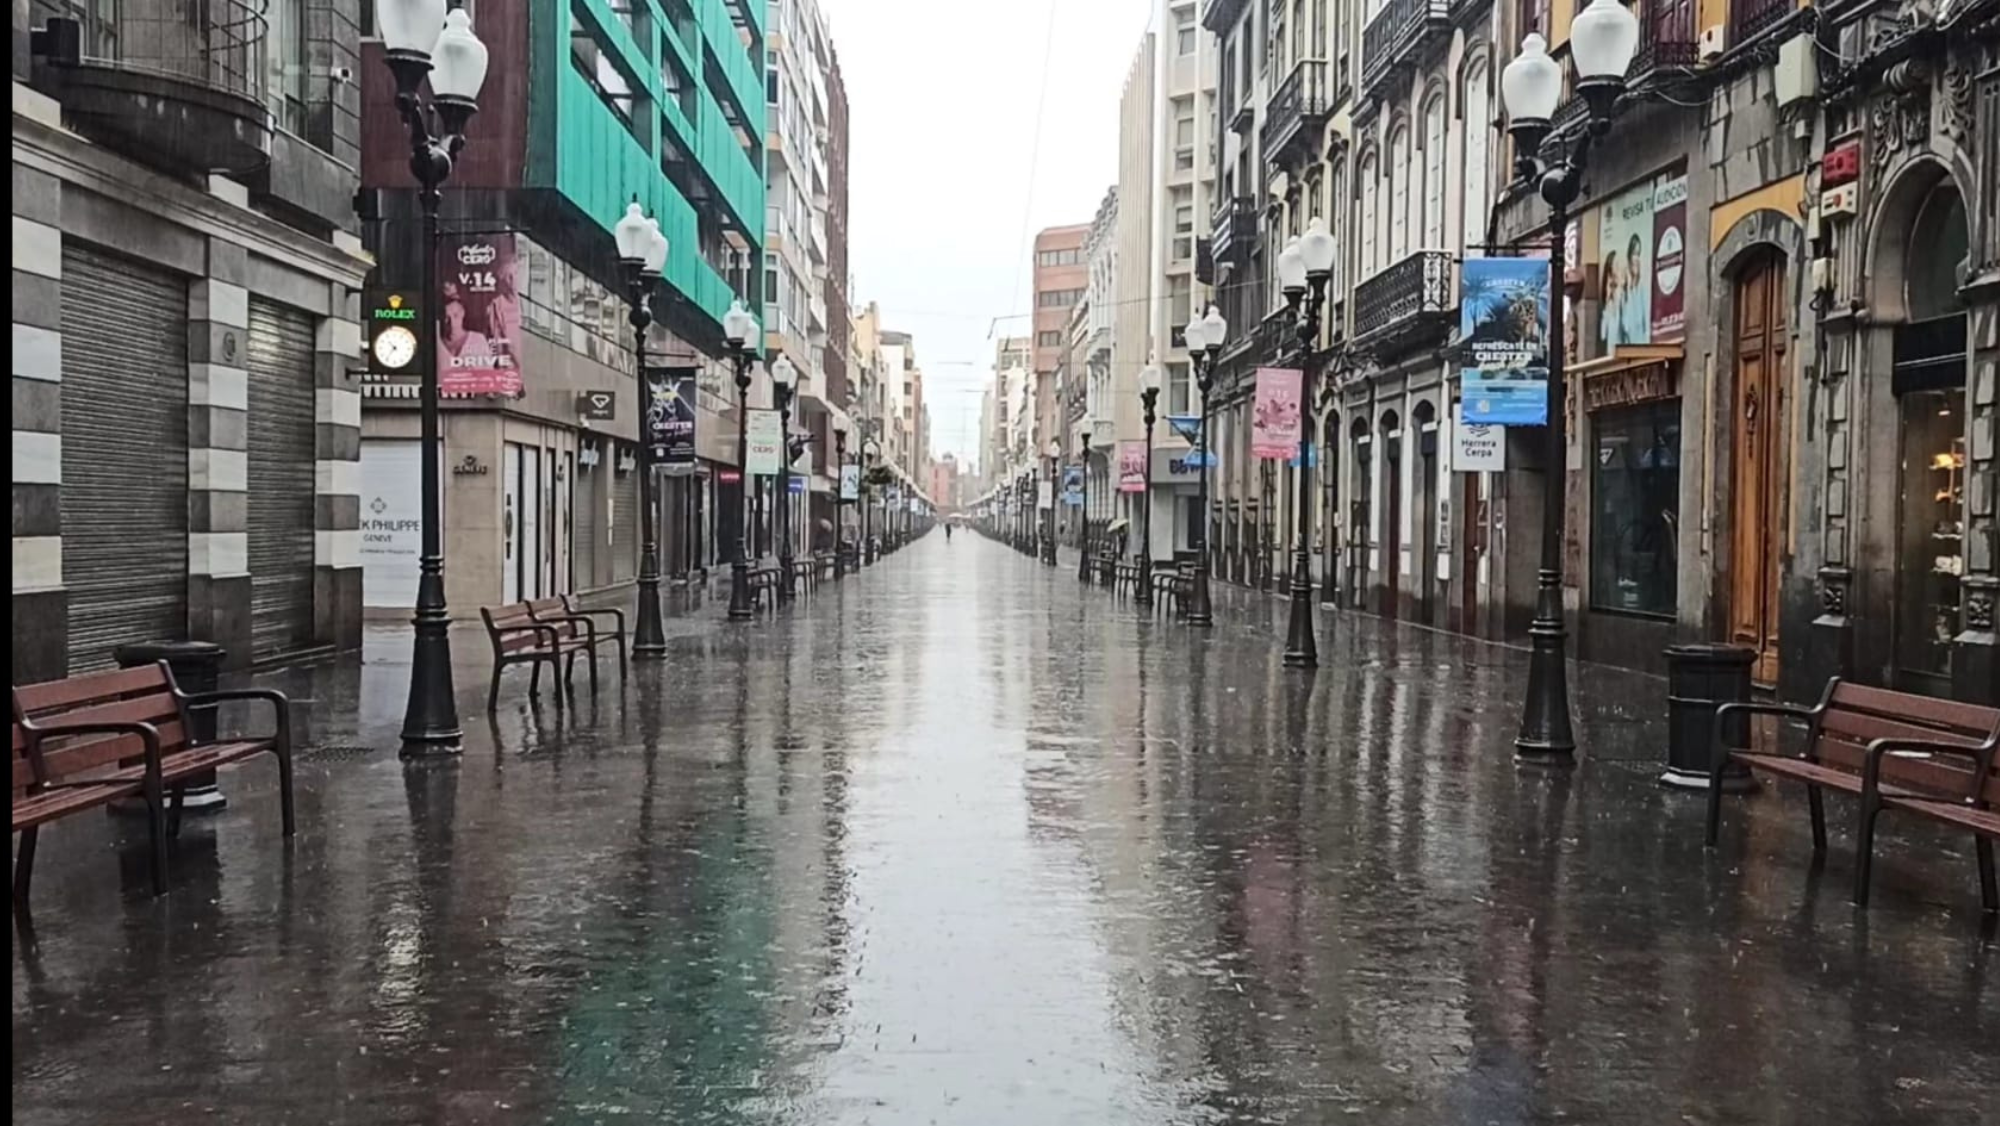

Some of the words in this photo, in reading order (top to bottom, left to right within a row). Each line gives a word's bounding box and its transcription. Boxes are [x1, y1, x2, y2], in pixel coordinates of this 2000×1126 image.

[463, 254, 490, 265] CERO
[375, 308, 415, 320] ROLEX
[450, 354, 511, 368] DRIVE
[1461, 439, 1497, 448] Herrera
[1465, 447, 1493, 458] Cerpa
[371, 519, 420, 532] PHILIPPE
